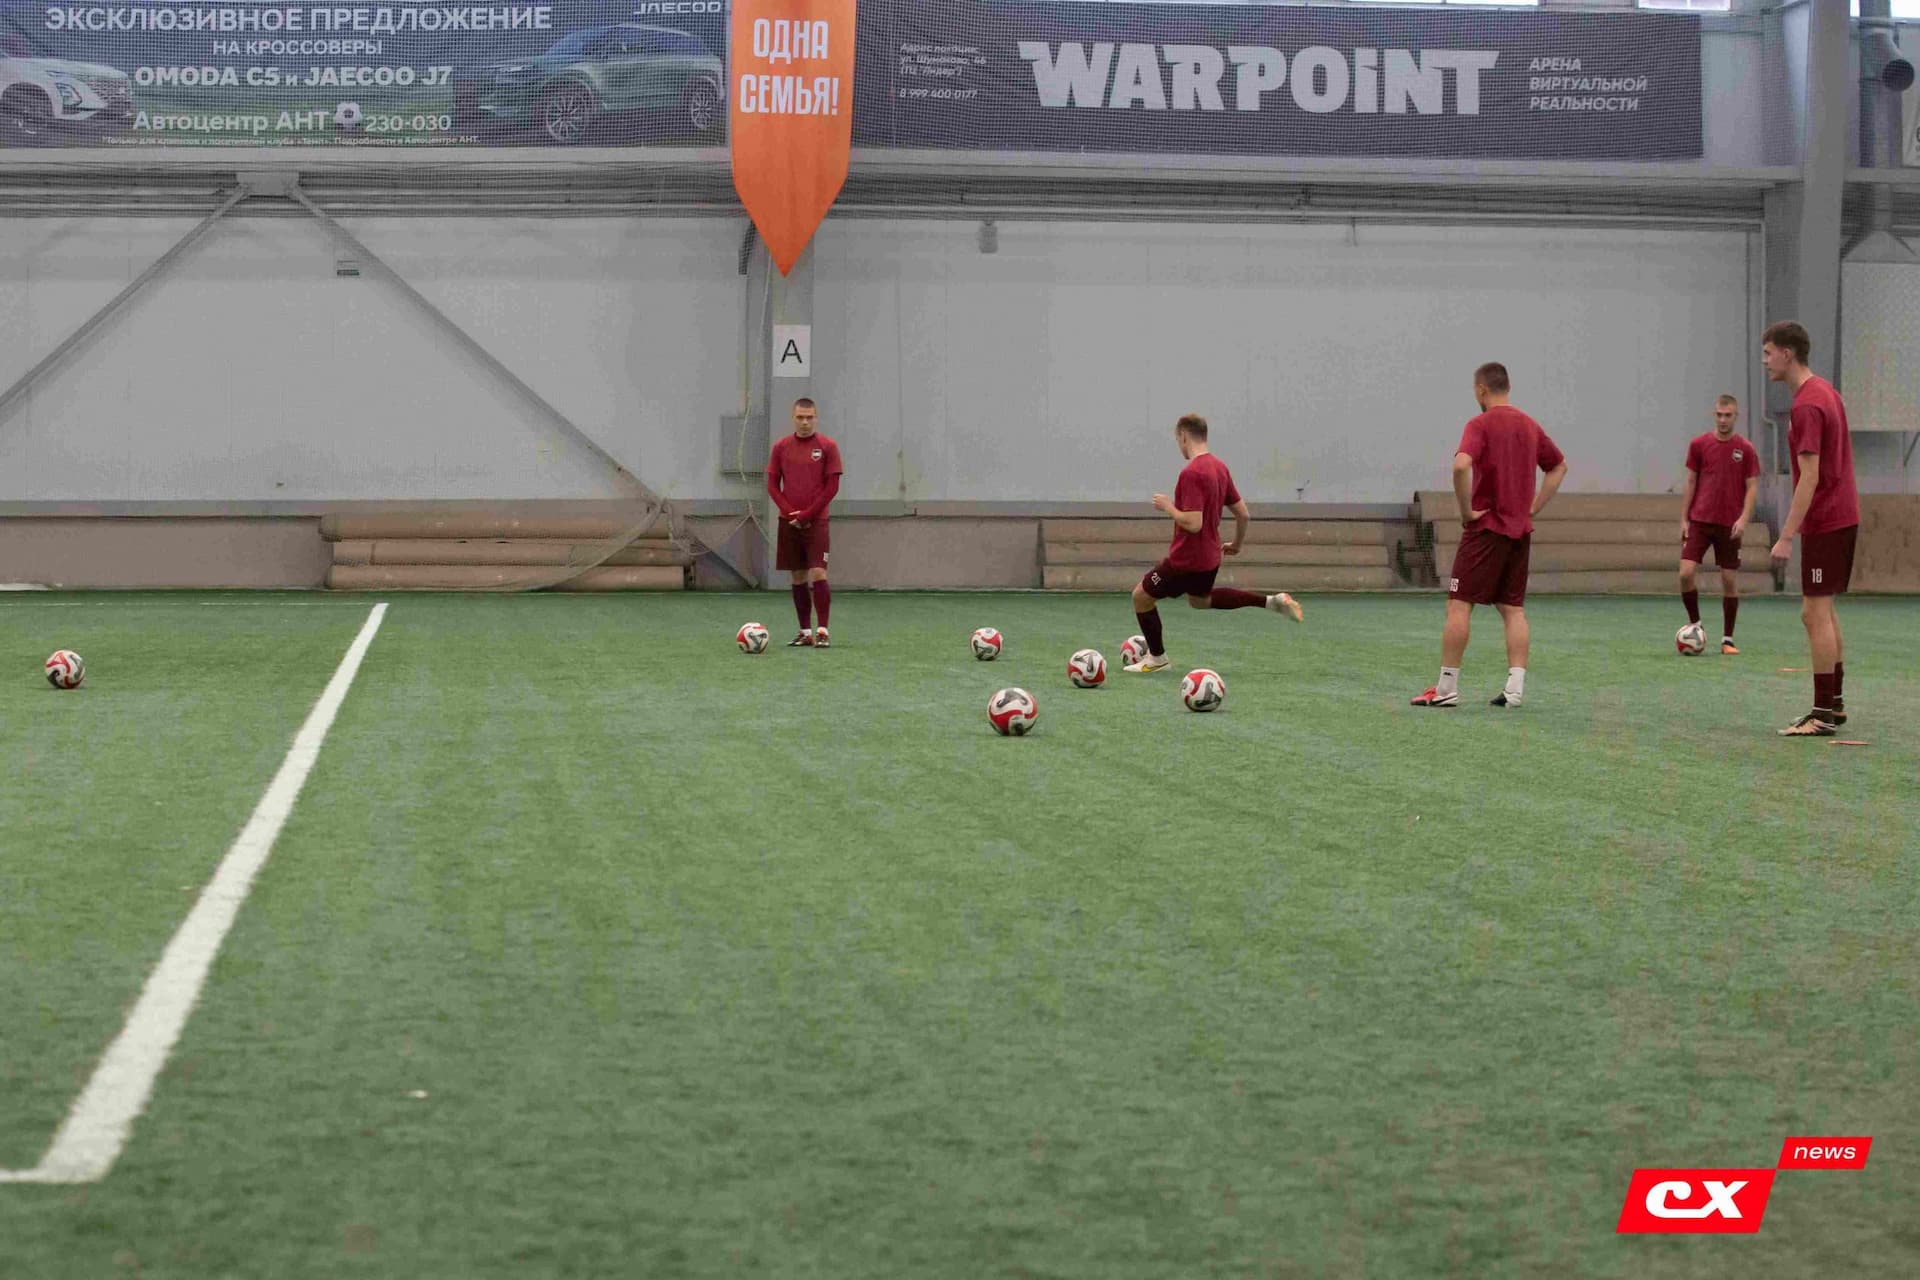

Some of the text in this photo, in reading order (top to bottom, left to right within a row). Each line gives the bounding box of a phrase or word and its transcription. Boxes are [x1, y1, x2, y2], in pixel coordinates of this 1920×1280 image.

[633, 1, 721, 14] JAECOO
[45, 7, 552, 34] ЭКСКЛЮЗИВНОЕ ПРЕДЛОЖЕНИЕ
[213, 40, 383, 55] НА КРОССОВЕРЫ
[753, 18, 829, 64] ОДНА
[1529, 57, 1581, 71] АРЕНА
[135, 65, 453, 86] OMODA C5 и JAECOO J7
[1529, 75, 1647, 91] ВИРТУАЛЬНОЙ
[740, 73, 840, 116] СЕМЬЯ!
[1530, 96, 1639, 111] РЕАЛЬНОСТИ
[133, 111, 452, 135] Автоцентр АНТ 230-030
[780, 338, 803, 364] A
[1811, 568, 1823, 583] 18
